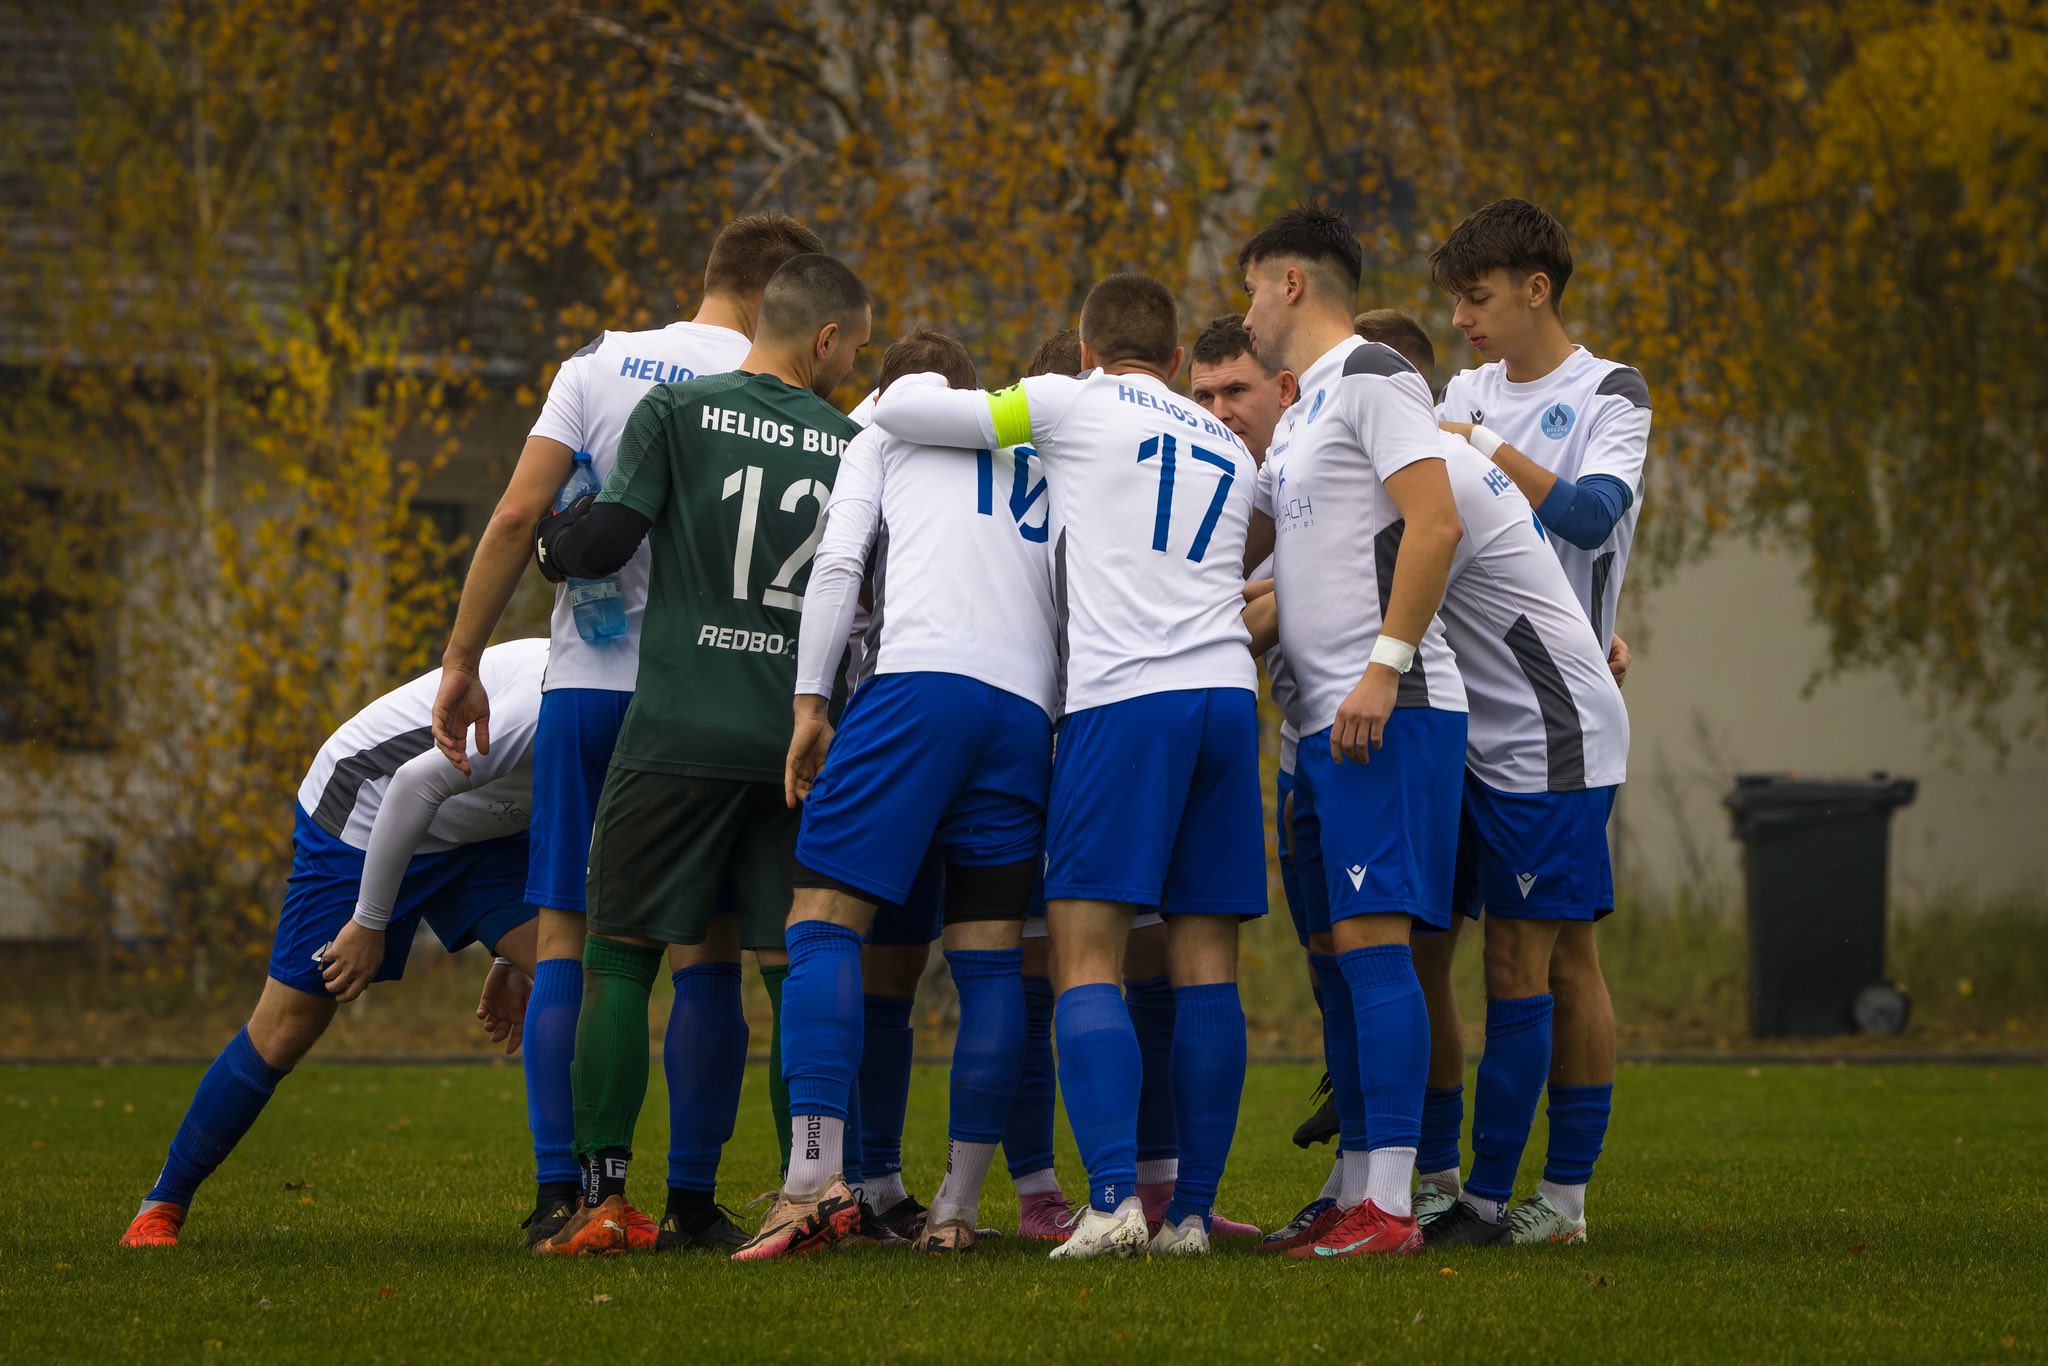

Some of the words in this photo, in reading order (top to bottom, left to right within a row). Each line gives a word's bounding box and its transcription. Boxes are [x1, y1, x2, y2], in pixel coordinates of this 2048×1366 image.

[620, 356, 704, 384] HELIO
[701, 405, 795, 447] HELIOS
[1118, 384, 1198, 427] HELIOS
[1136, 432, 1235, 563] 17
[721, 465, 833, 612] 12
